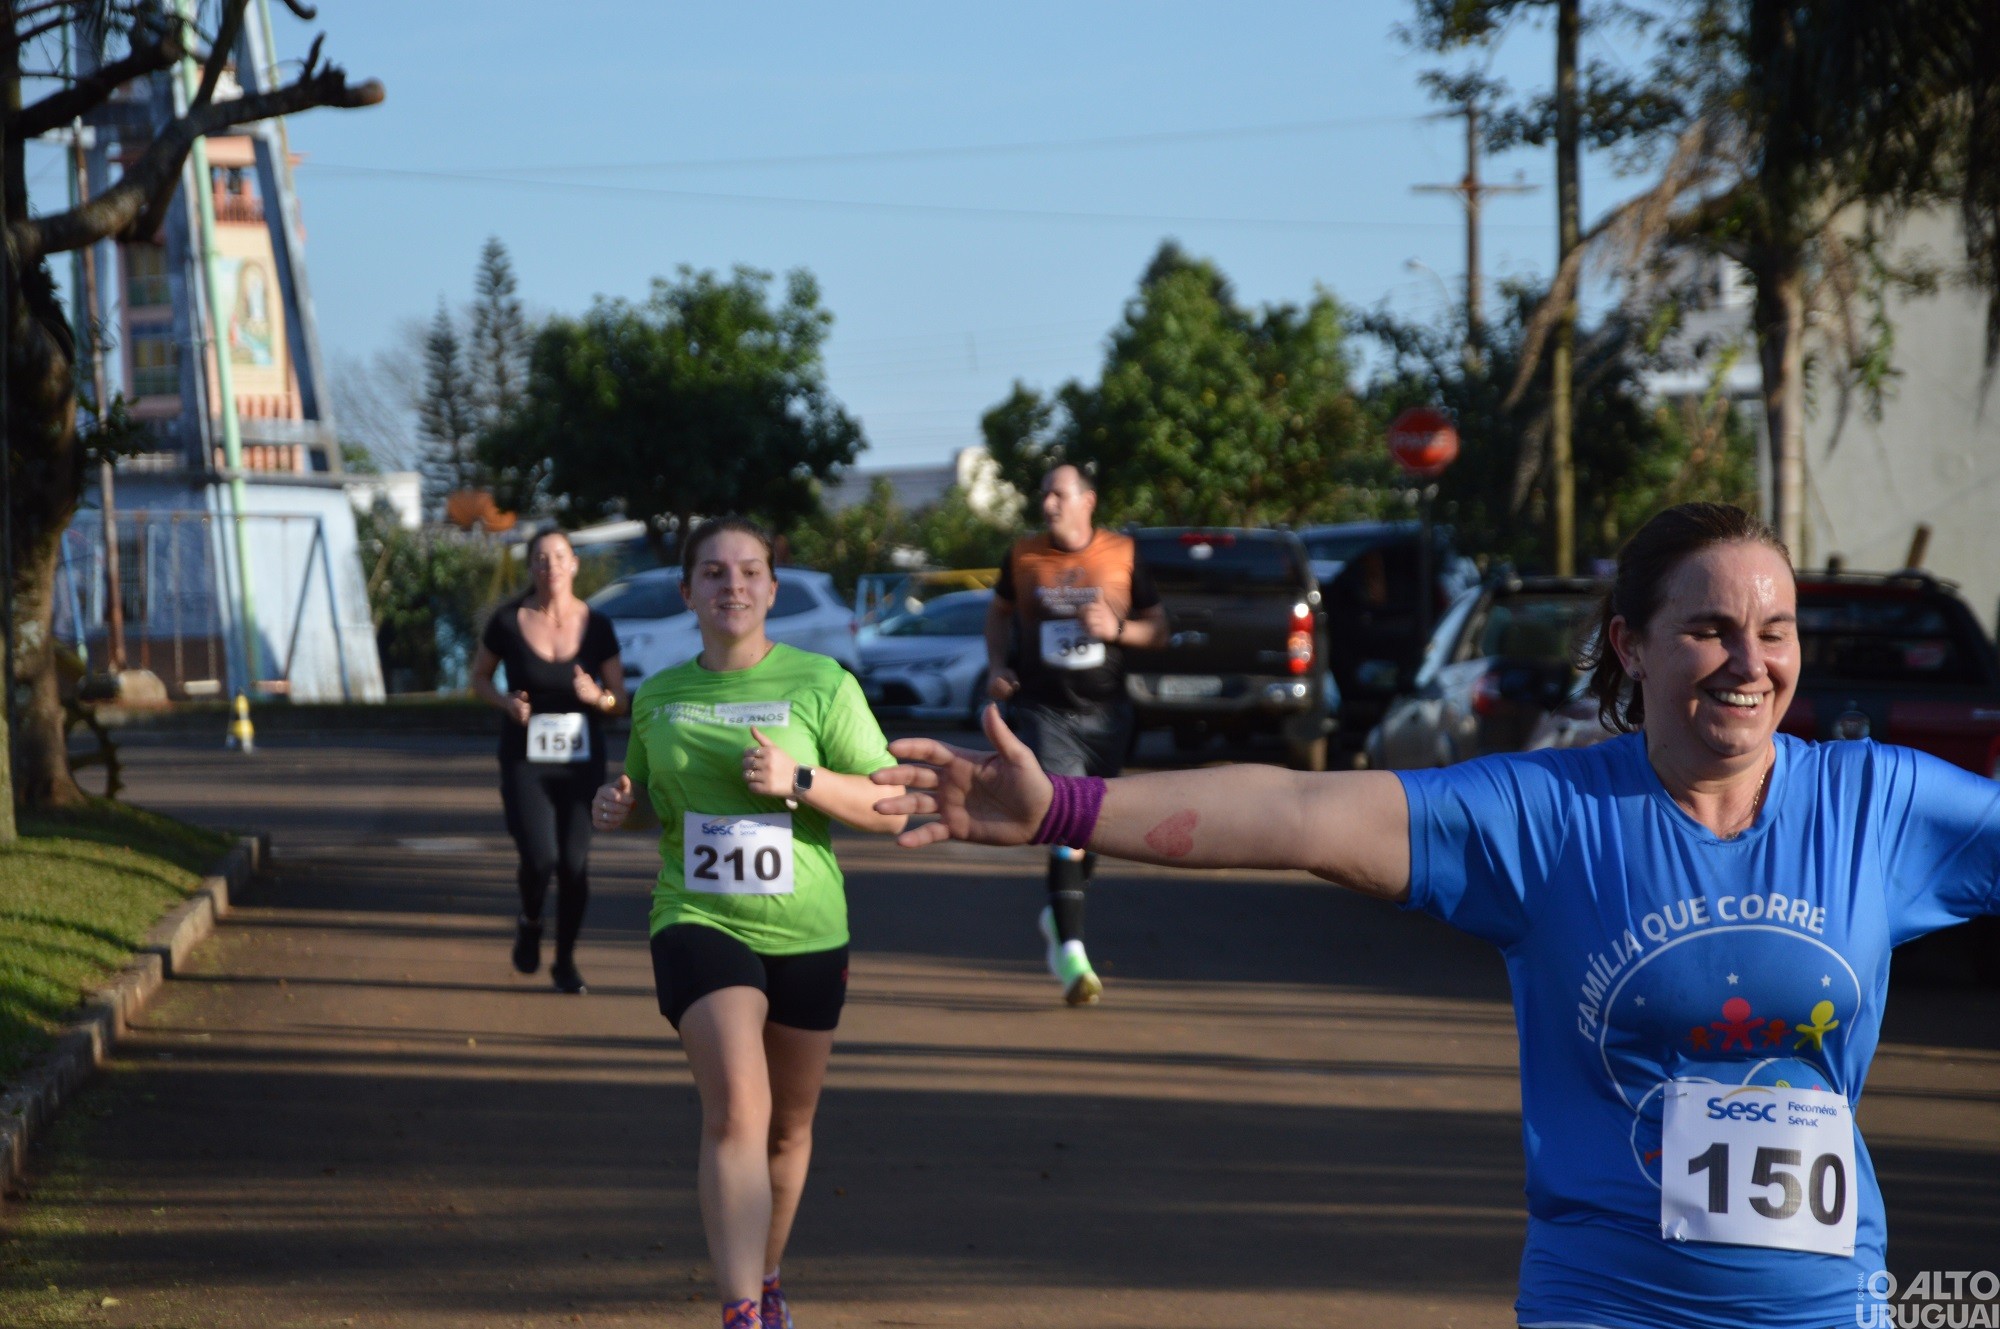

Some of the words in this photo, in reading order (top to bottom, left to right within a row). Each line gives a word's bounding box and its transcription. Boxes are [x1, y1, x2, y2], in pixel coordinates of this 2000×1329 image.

[747, 713, 785, 723] ANOS
[693, 844, 782, 881] 210
[1578, 928, 1644, 1042] FAMÍLIA
[1641, 896, 1710, 943] QUE
[1717, 893, 1826, 935] CORRE
[1788, 1116, 1819, 1128] Senac
[1688, 1142, 1846, 1226] 150
